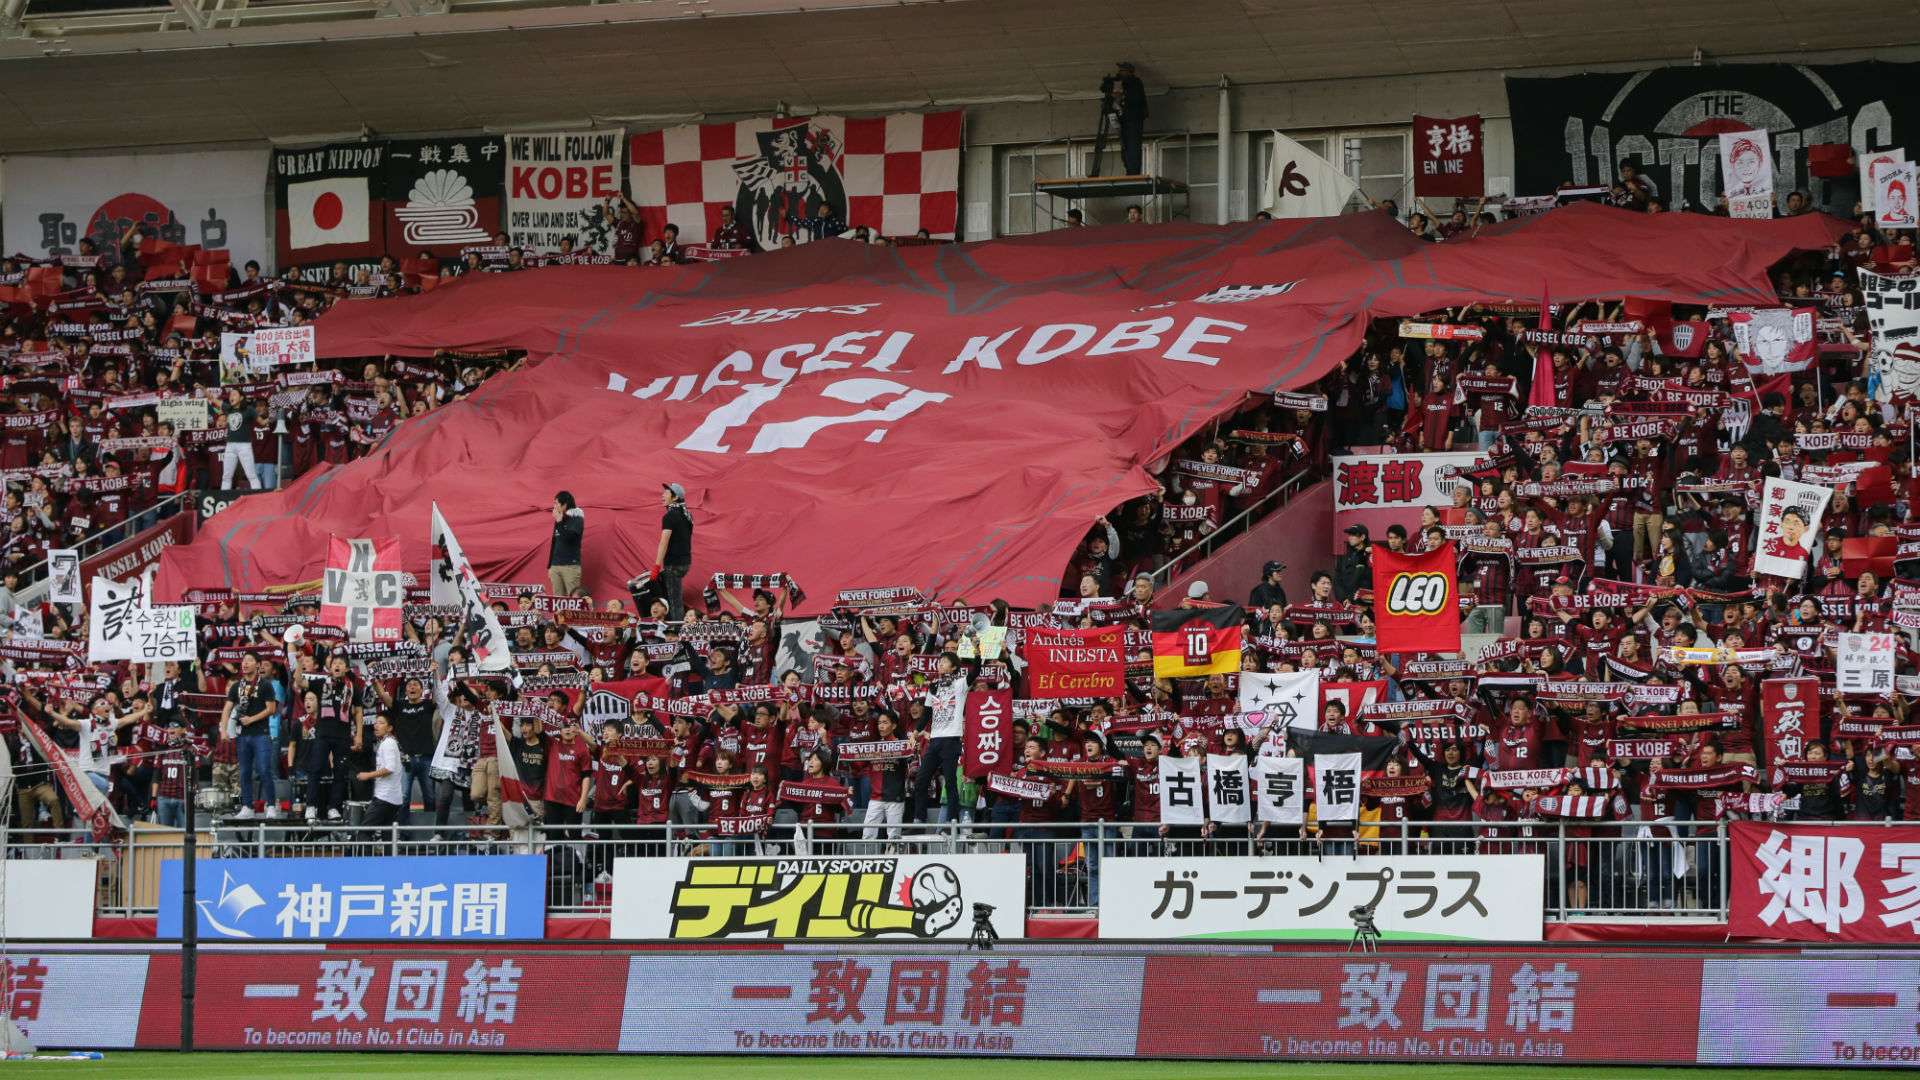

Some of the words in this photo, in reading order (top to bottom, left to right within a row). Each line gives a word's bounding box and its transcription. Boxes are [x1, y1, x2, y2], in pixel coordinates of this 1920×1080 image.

[1702, 95, 1743, 116] THE
[392, 142, 500, 165] 一戦集中
[512, 137, 530, 161] WE
[532, 136, 561, 161] WILL
[565, 135, 615, 161] FOLLOW
[278, 152, 325, 176] GREAT
[329, 146, 384, 170] NIPPON
[512, 165, 618, 199] KOBE
[513, 212, 530, 229] OVER
[551, 212, 564, 228] AND
[565, 211, 579, 227] SEA
[943, 316, 1249, 375] KOBE
[1525, 331, 1558, 344] VISSEL
[1561, 334, 1588, 347] KOBE
[1685, 393, 1720, 407] KOBE
[1612, 424, 1631, 438] BE
[1631, 421, 1664, 436] KOBE
[85, 478, 101, 491] BE
[102, 475, 129, 489] KOBE
[1337, 460, 1424, 506] 渡部
[1163, 506, 1178, 519] BE
[1763, 486, 1787, 555] 郷家友太
[1530, 548, 1558, 561] NEVER
[1731, 541, 1740, 553] 8
[328, 570, 348, 603] V
[375, 574, 397, 606] C
[841, 590, 866, 602] NEVER
[868, 588, 901, 601] FORGET
[1389, 577, 1446, 612] LEO
[535, 598, 549, 611] BE
[552, 598, 583, 612] KOBE
[1574, 595, 1590, 608] BE
[1593, 595, 1629, 608] KOBE
[136, 609, 177, 630] 수호신
[179, 609, 192, 629] 18
[1010, 614, 1022, 627] BE
[373, 626, 399, 640] 1995
[1032, 633, 1085, 647] Andrés
[140, 631, 193, 658] 김승규
[343, 643, 390, 656] VISSEL
[648, 644, 675, 657] NEVER
[1187, 633, 1208, 656] 10
[1869, 635, 1892, 652] 24
[518, 653, 545, 664] NEVER
[547, 653, 577, 664] FORGET
[912, 656, 925, 670] BE
[1049, 648, 1119, 663] INIESTA
[1408, 662, 1435, 675] NEVER
[1436, 661, 1470, 674] FORGET
[1038, 673, 1057, 689] El
[1059, 672, 1115, 689] Cerebro
[1843, 669, 1892, 689] 三原
[727, 688, 741, 702] BE
[743, 686, 771, 701] KOBE
[1546, 683, 1575, 696] NEVER
[1577, 684, 1613, 698] FORGET
[1646, 686, 1671, 697] KOBE
[652, 699, 666, 713] BE
[668, 700, 695, 715] KOBE
[1378, 701, 1405, 714] NEVER
[1407, 699, 1442, 712] FORGET
[1643, 717, 1678, 731] VISSEL
[1680, 716, 1714, 729] KOBE
[1408, 725, 1457, 741] VISSEL
[847, 743, 874, 755] NEVER
[1516, 746, 1528, 758] 12
[1615, 742, 1634, 757] BE
[1636, 741, 1672, 757] KOBE
[755, 752, 767, 764] 17
[167, 766, 179, 781] 10
[1491, 771, 1524, 783] VISSEL
[1525, 769, 1553, 782] KOBE
[1661, 774, 1686, 785] VISSEL
[1687, 773, 1708, 785] KOBE
[1809, 767, 1828, 778] KOBE
[1149, 783, 1160, 796] 10
[1165, 771, 1196, 807] 古
[1212, 768, 1245, 806] 橋
[1395, 805, 1404, 819] 8
[1653, 803, 1665, 816] 12
[720, 819, 735, 834] BE
[777, 859, 828, 875] DAILY
[829, 858, 896, 874] SPORTS
[1150, 867, 1489, 921] ガーデンプラス
[275, 881, 508, 939] 神戸新聞
[243, 957, 524, 1025] 一致団結
[732, 957, 1031, 1028] 一致団結
[1257, 960, 1581, 1035] 一致団結
[244, 1027, 263, 1045] To
[266, 1027, 338, 1046] become
[342, 1027, 364, 1046] the
[367, 1028, 402, 1047] No.1
[407, 1028, 443, 1047] Club
[448, 1029, 462, 1047] in
[466, 1029, 505, 1047] Asia
[735, 1030, 754, 1049] To
[757, 1030, 830, 1050] become
[833, 1030, 861, 1050] the
[866, 1031, 906, 1050] No.1
[909, 1031, 949, 1051] Club
[953, 1031, 967, 1051] in
[967, 1032, 1013, 1052] Asia
[1261, 1035, 1280, 1054] To
[1286, 1036, 1362, 1056] become
[1367, 1036, 1397, 1056] the
[1402, 1037, 1444, 1057] No.1
[1448, 1038, 1493, 1058] Club
[1498, 1038, 1515, 1058] in
[1519, 1038, 1564, 1059] Asia
[1832, 1042, 1857, 1061] To
[1862, 1042, 1920, 1063] beco
